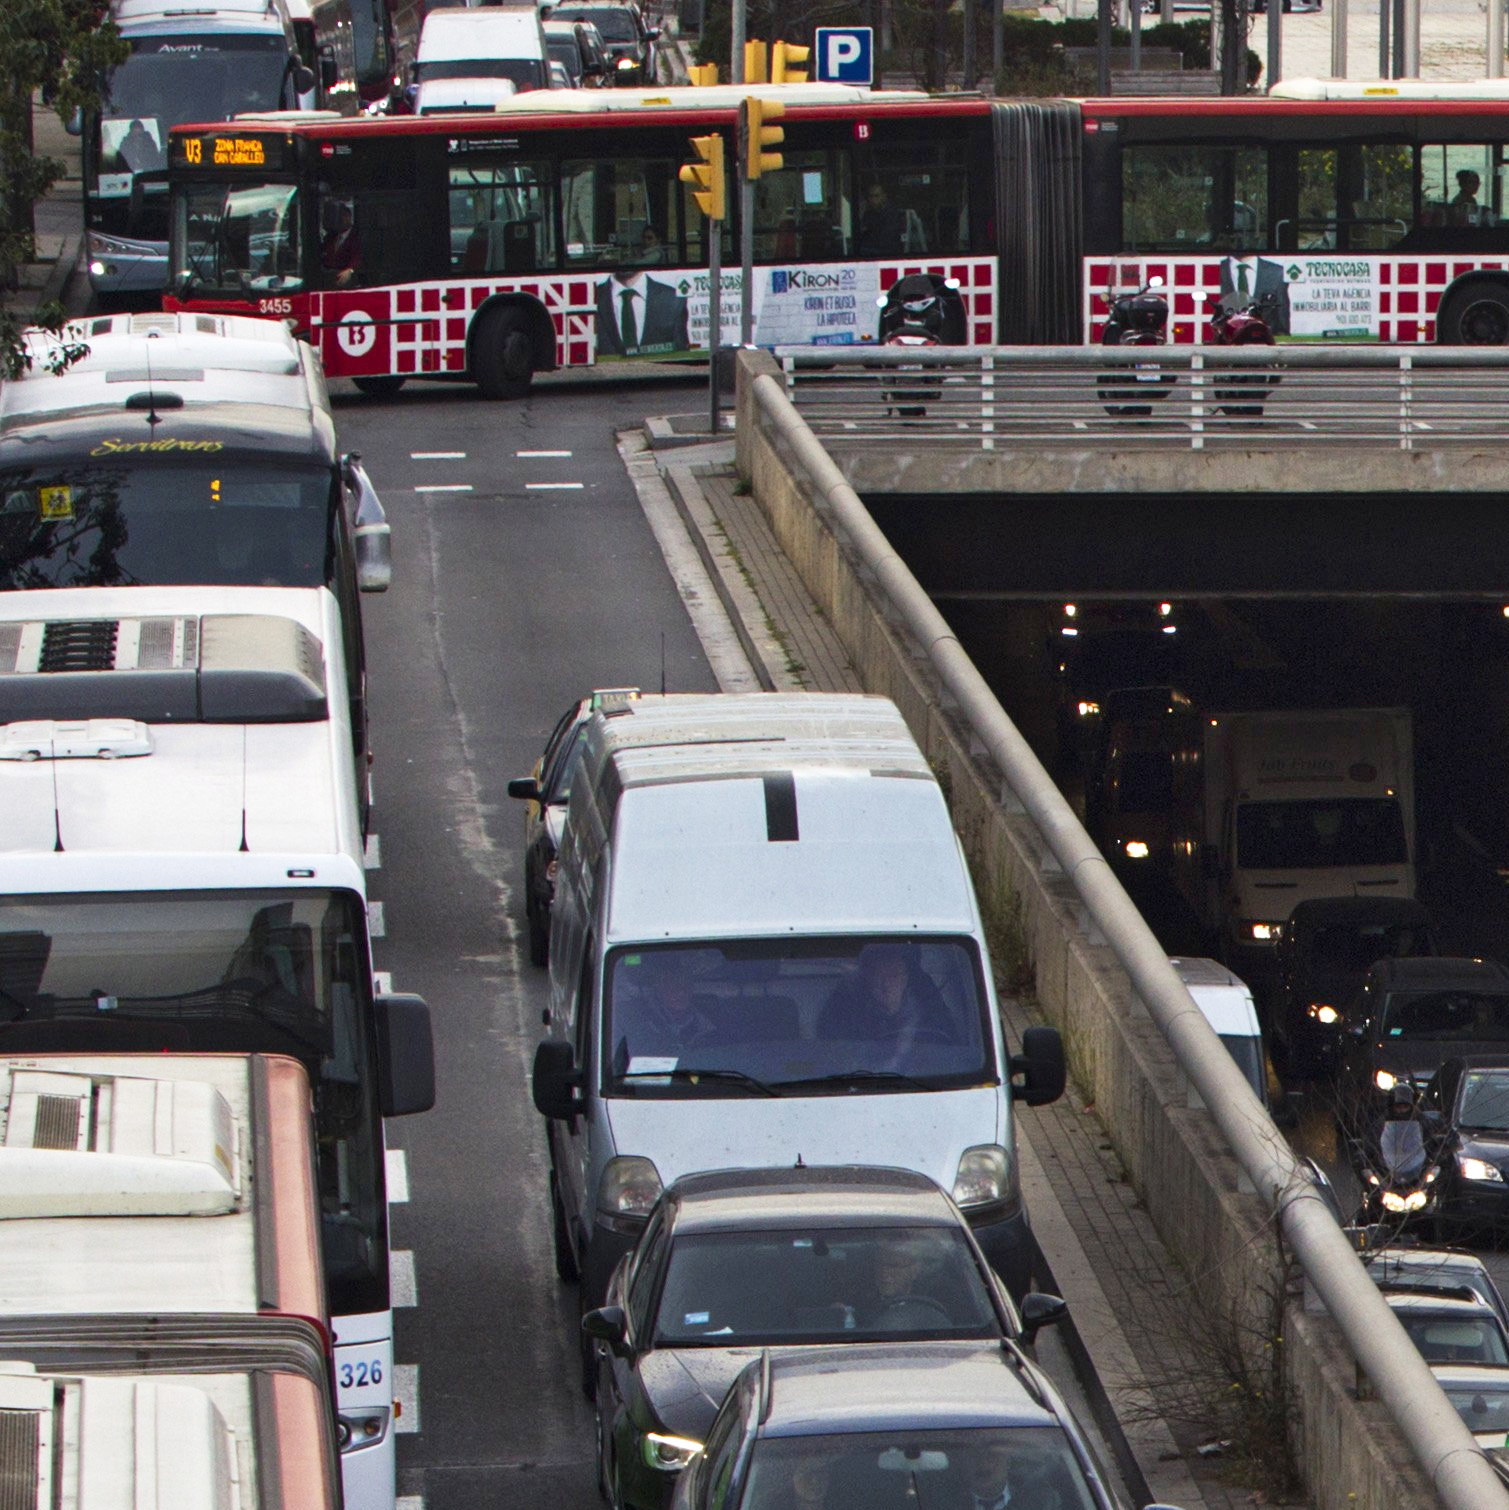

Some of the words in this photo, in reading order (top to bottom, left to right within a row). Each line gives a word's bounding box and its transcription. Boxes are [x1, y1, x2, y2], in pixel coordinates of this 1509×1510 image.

[828, 33, 862, 78] P
[1306, 262, 1371, 277] TECNOCASA
[259, 299, 292, 314] 3455
[91, 437, 224, 456] Servitrans
[339, 1359, 383, 1389] 326
